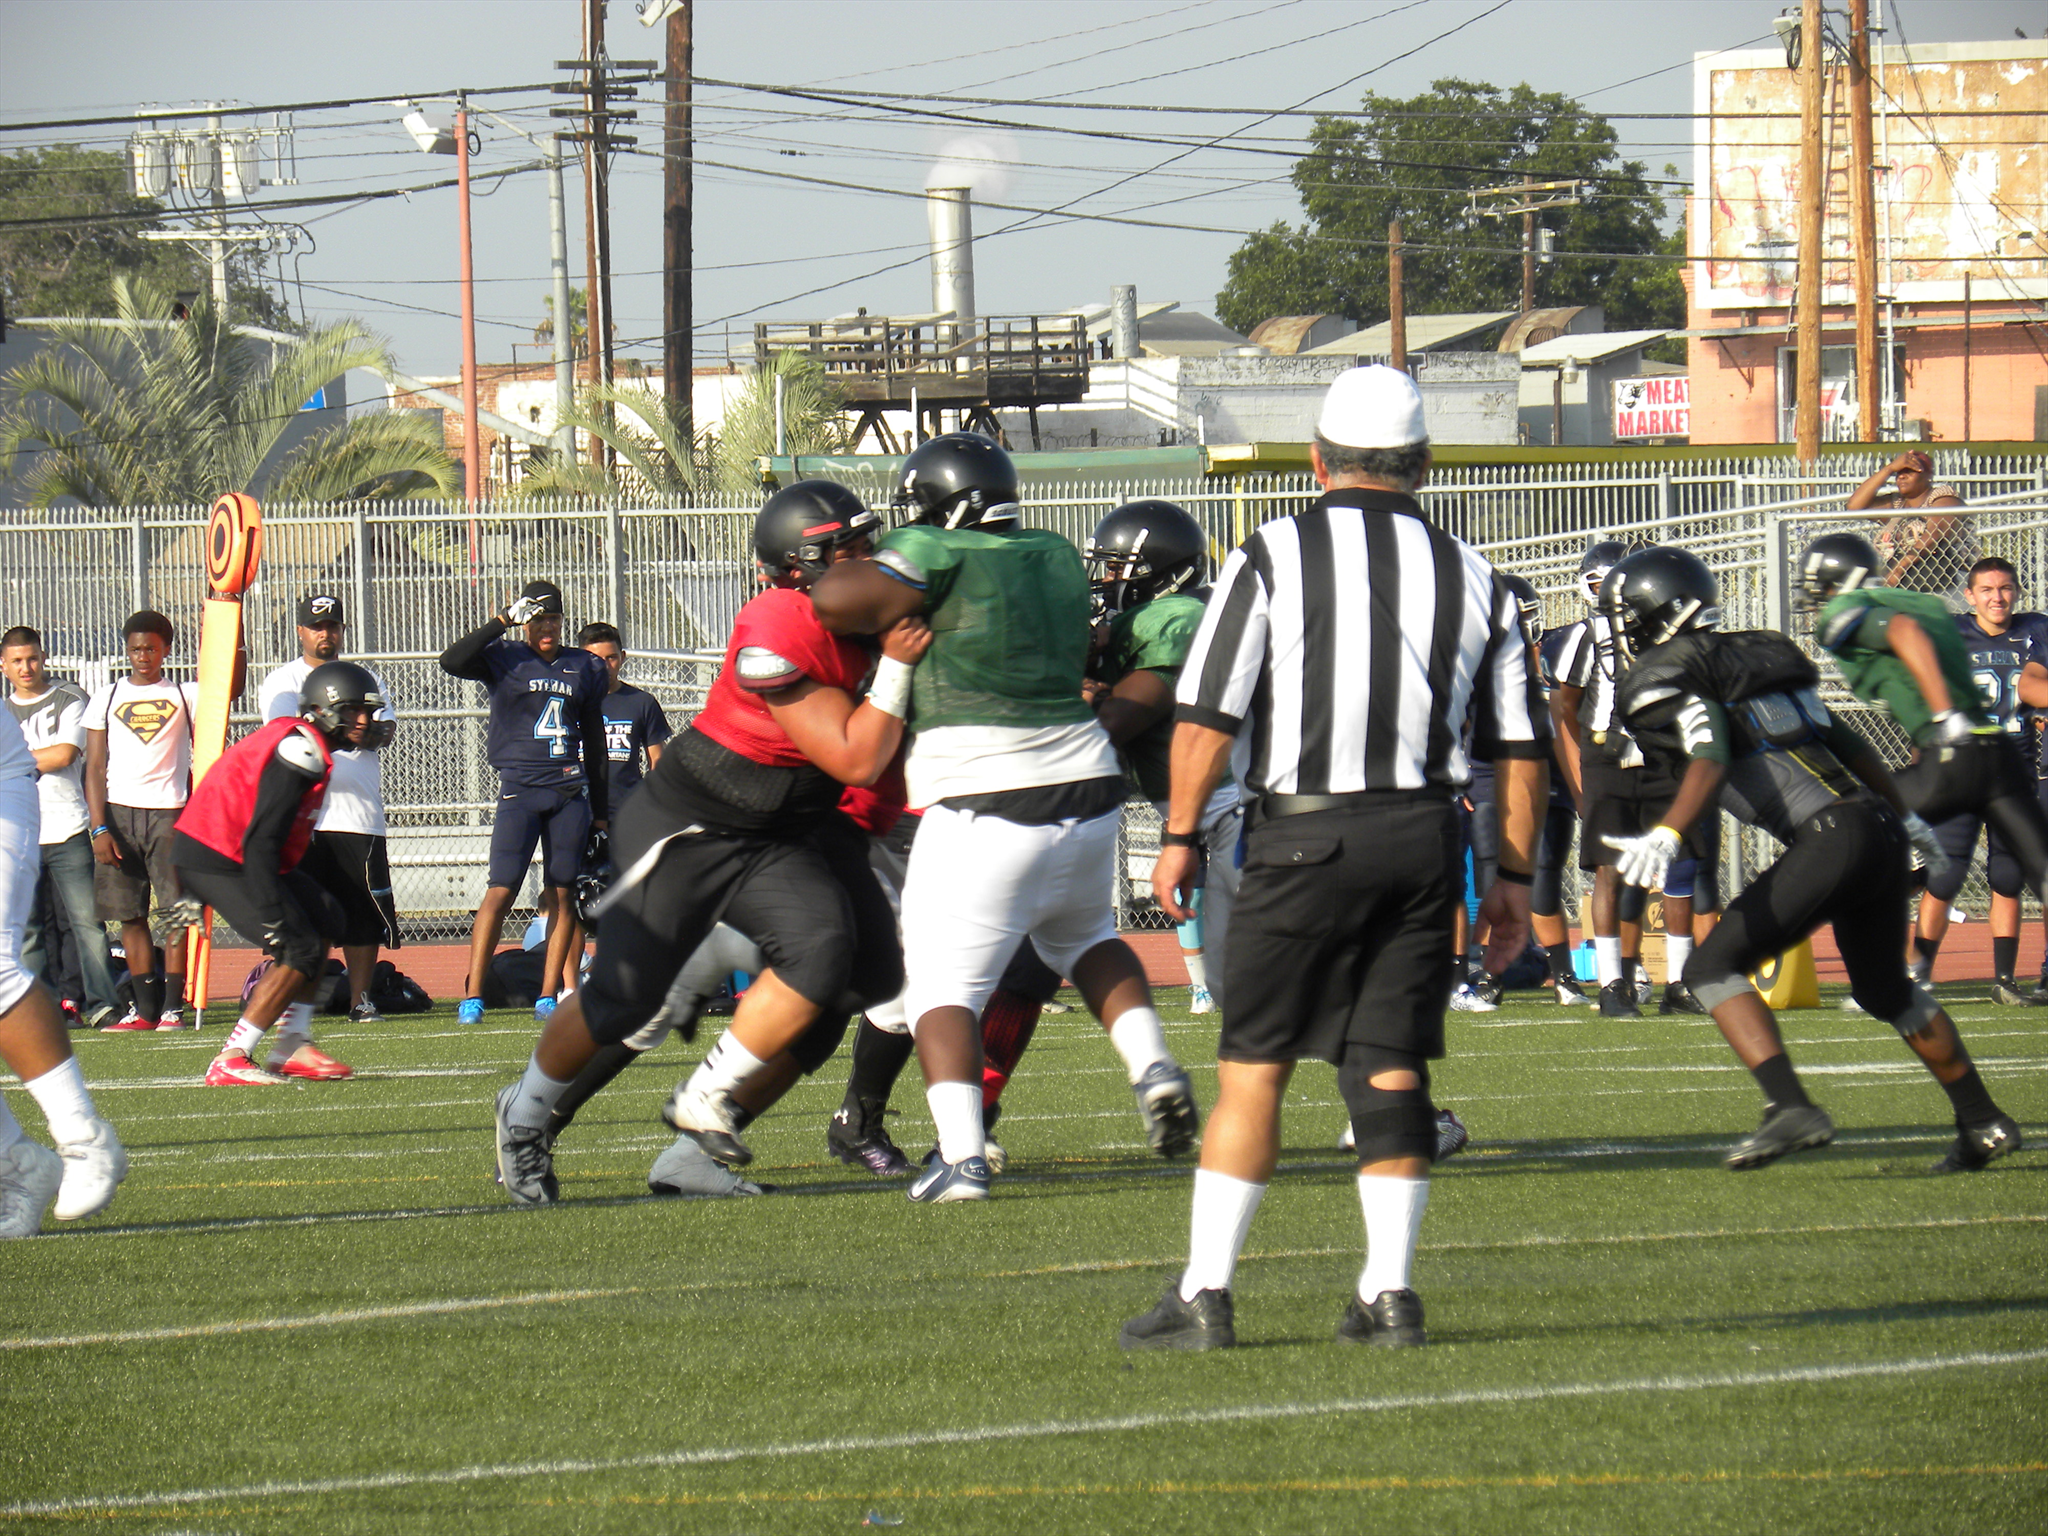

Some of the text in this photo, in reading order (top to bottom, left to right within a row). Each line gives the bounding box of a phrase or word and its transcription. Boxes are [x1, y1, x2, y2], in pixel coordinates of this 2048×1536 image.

[529, 679, 573, 696] SYLMAR
[534, 696, 569, 758] 4
[614, 724, 632, 734] THE
